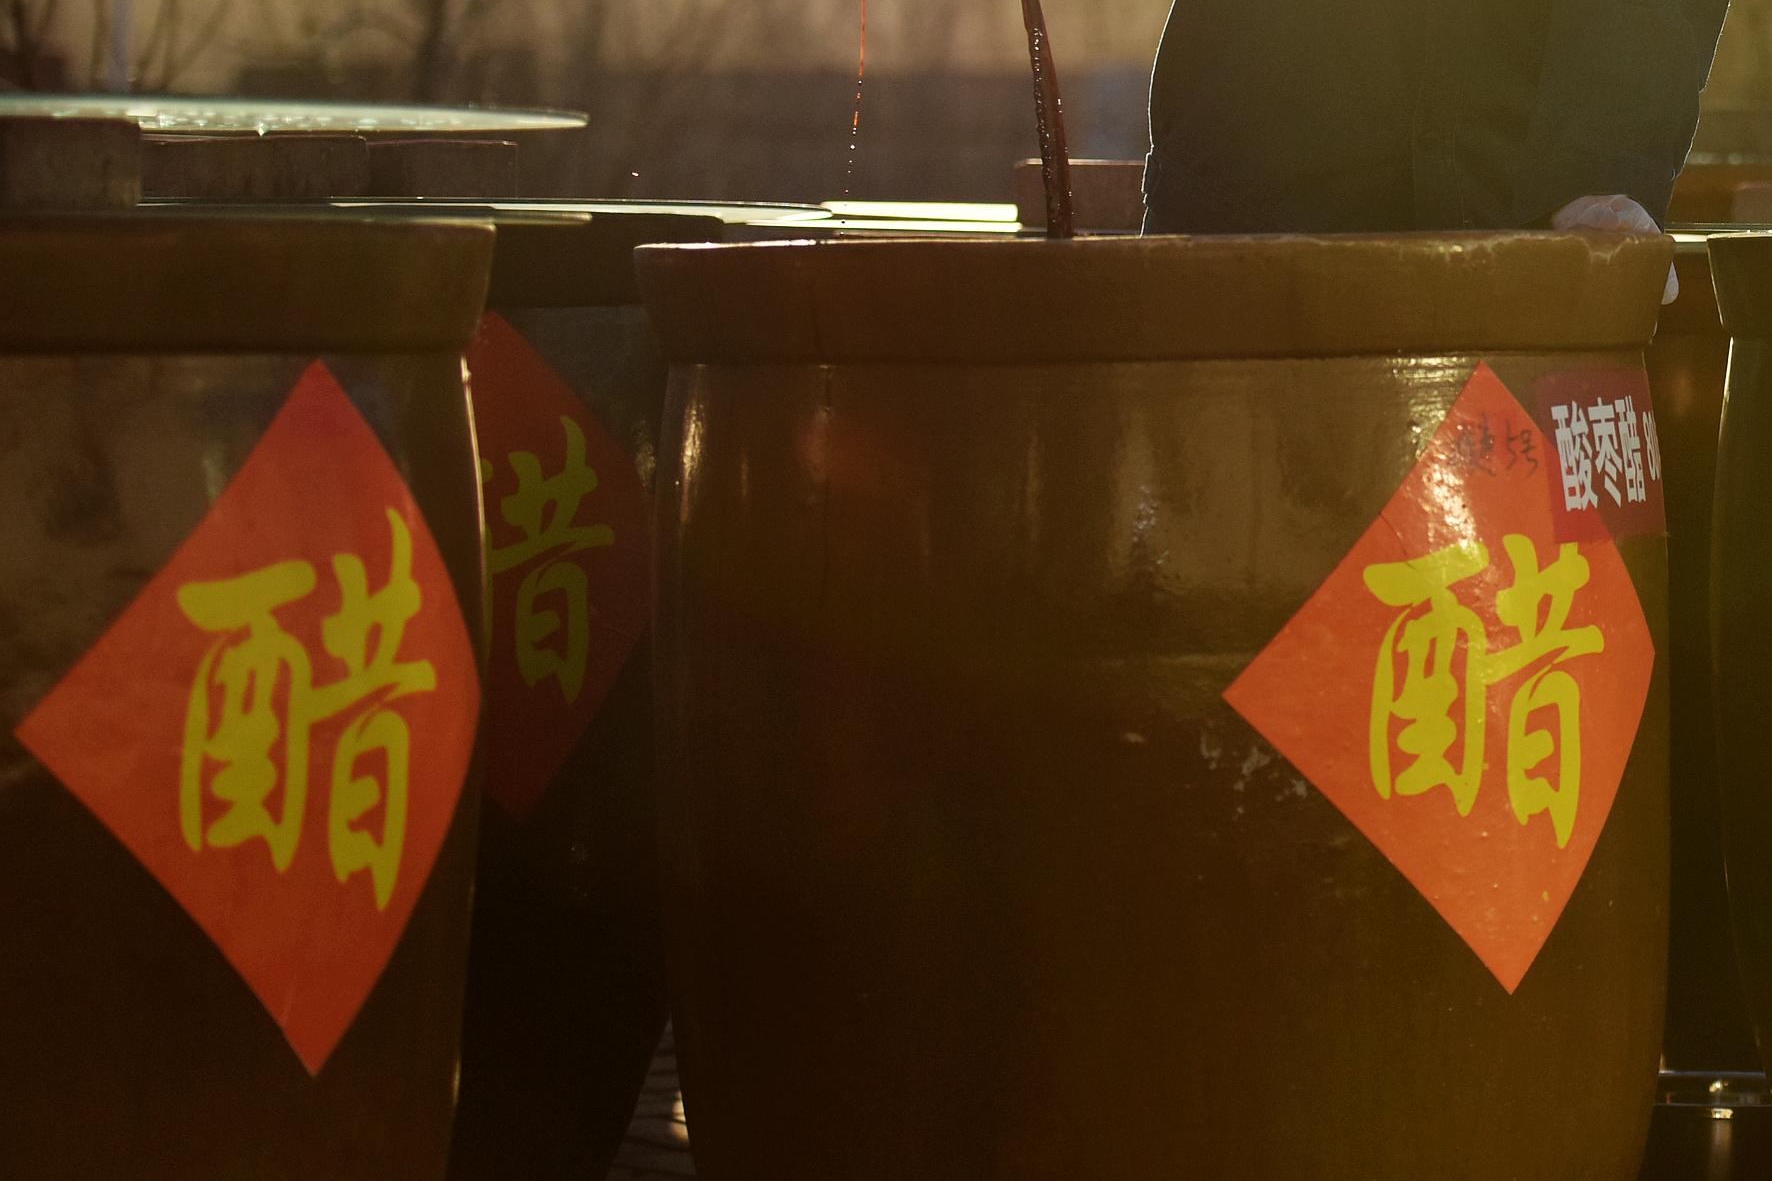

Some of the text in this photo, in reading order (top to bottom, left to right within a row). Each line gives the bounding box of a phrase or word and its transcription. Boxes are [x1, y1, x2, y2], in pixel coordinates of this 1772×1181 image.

[1551, 396, 1646, 511] 酸枣醋
[178, 507, 436, 911] 醋
[1363, 534, 1604, 850] 醋
